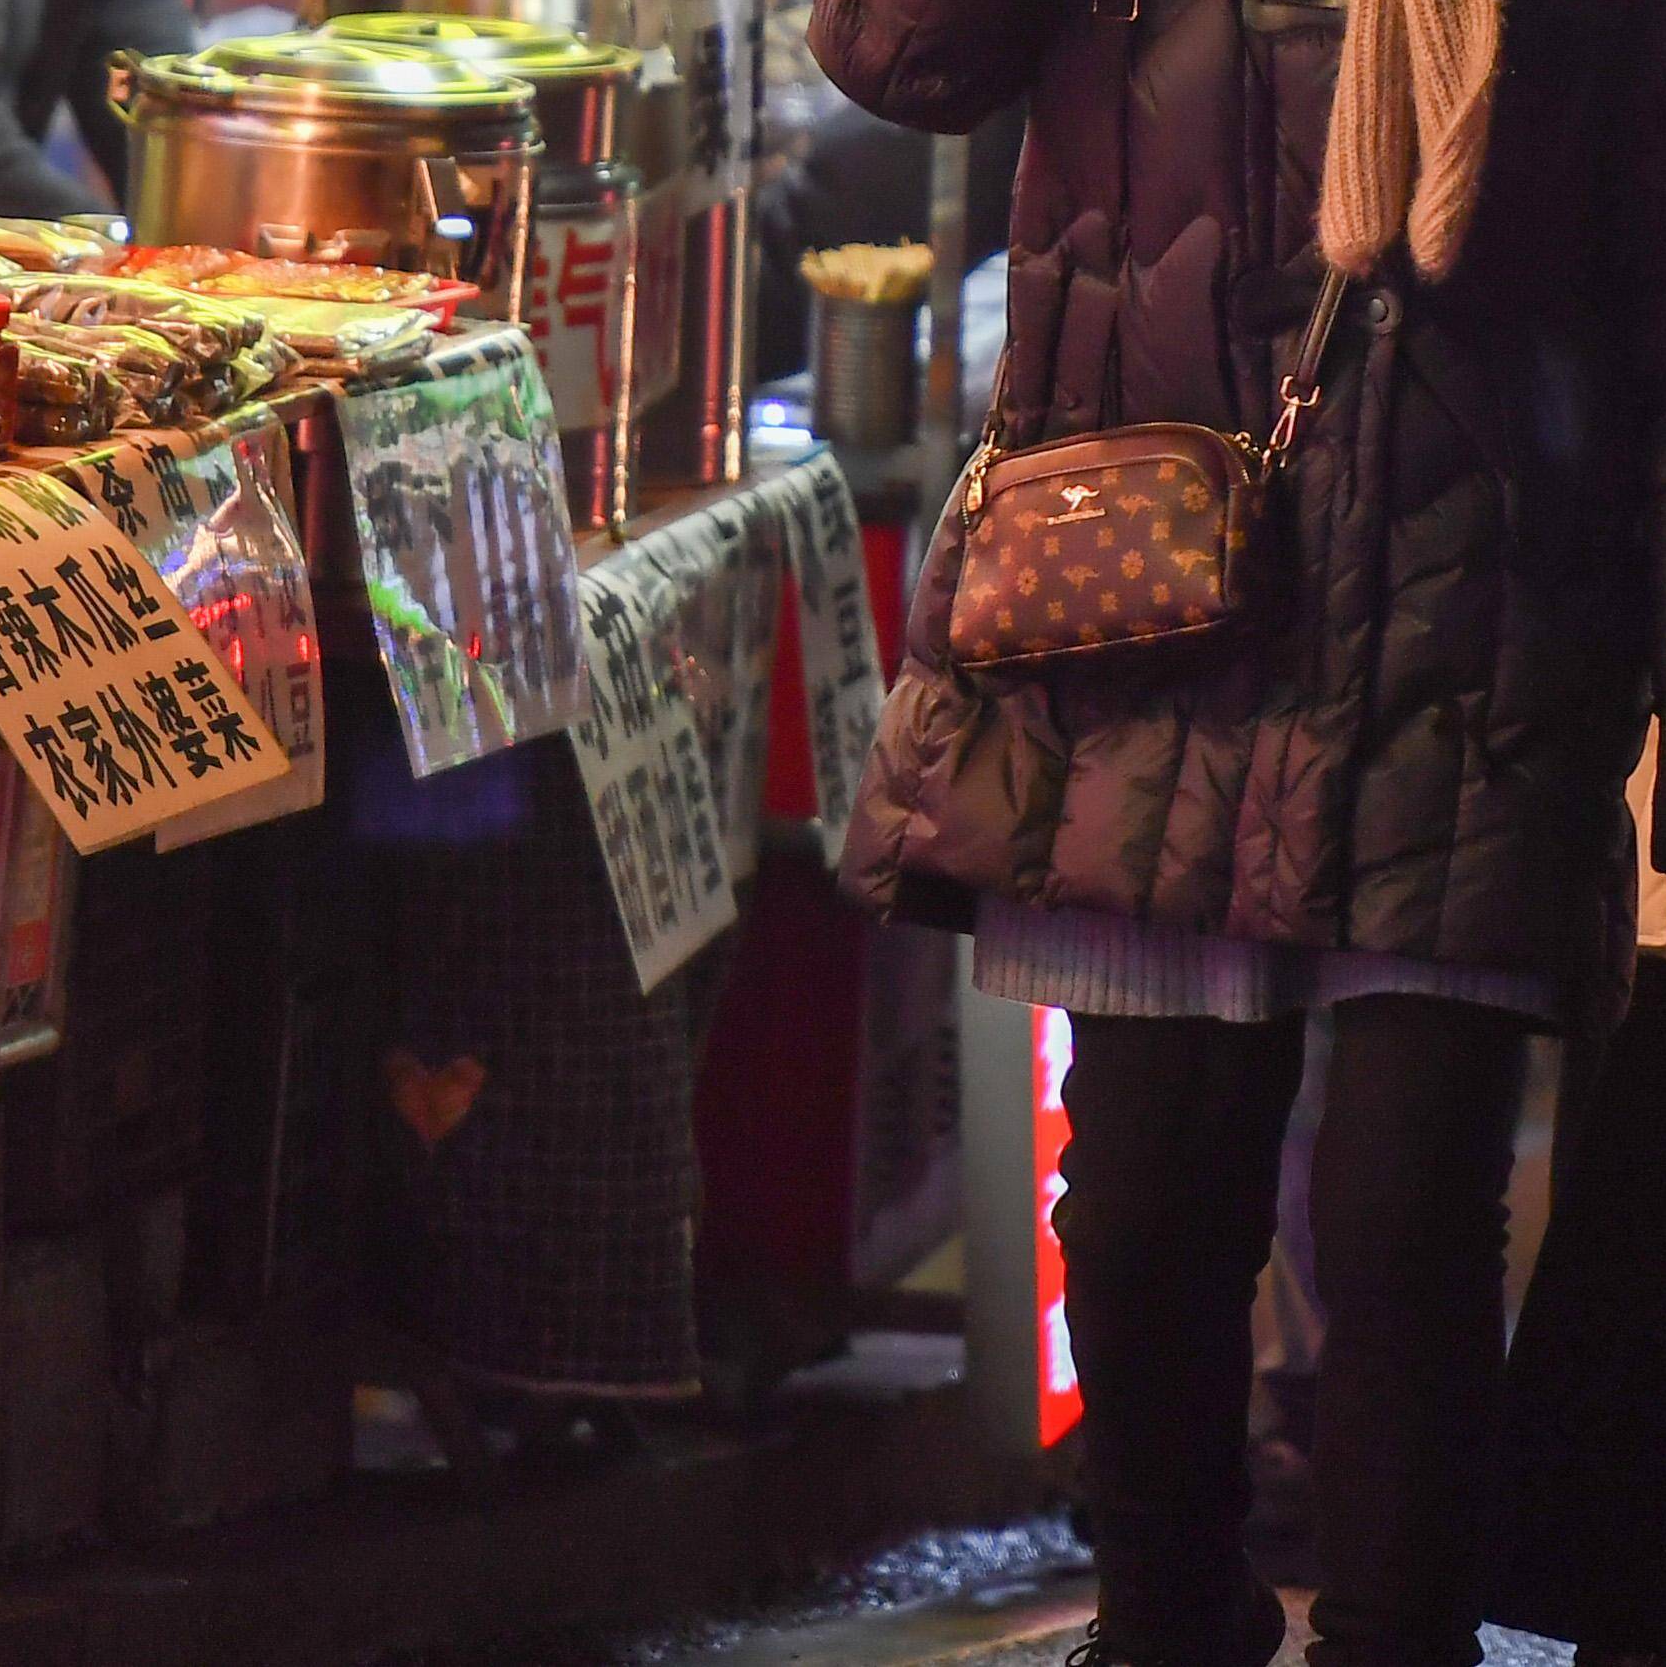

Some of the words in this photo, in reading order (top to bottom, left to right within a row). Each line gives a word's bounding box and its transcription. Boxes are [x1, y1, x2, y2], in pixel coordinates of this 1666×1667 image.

[23, 658, 263, 821] 农家外婆菜
